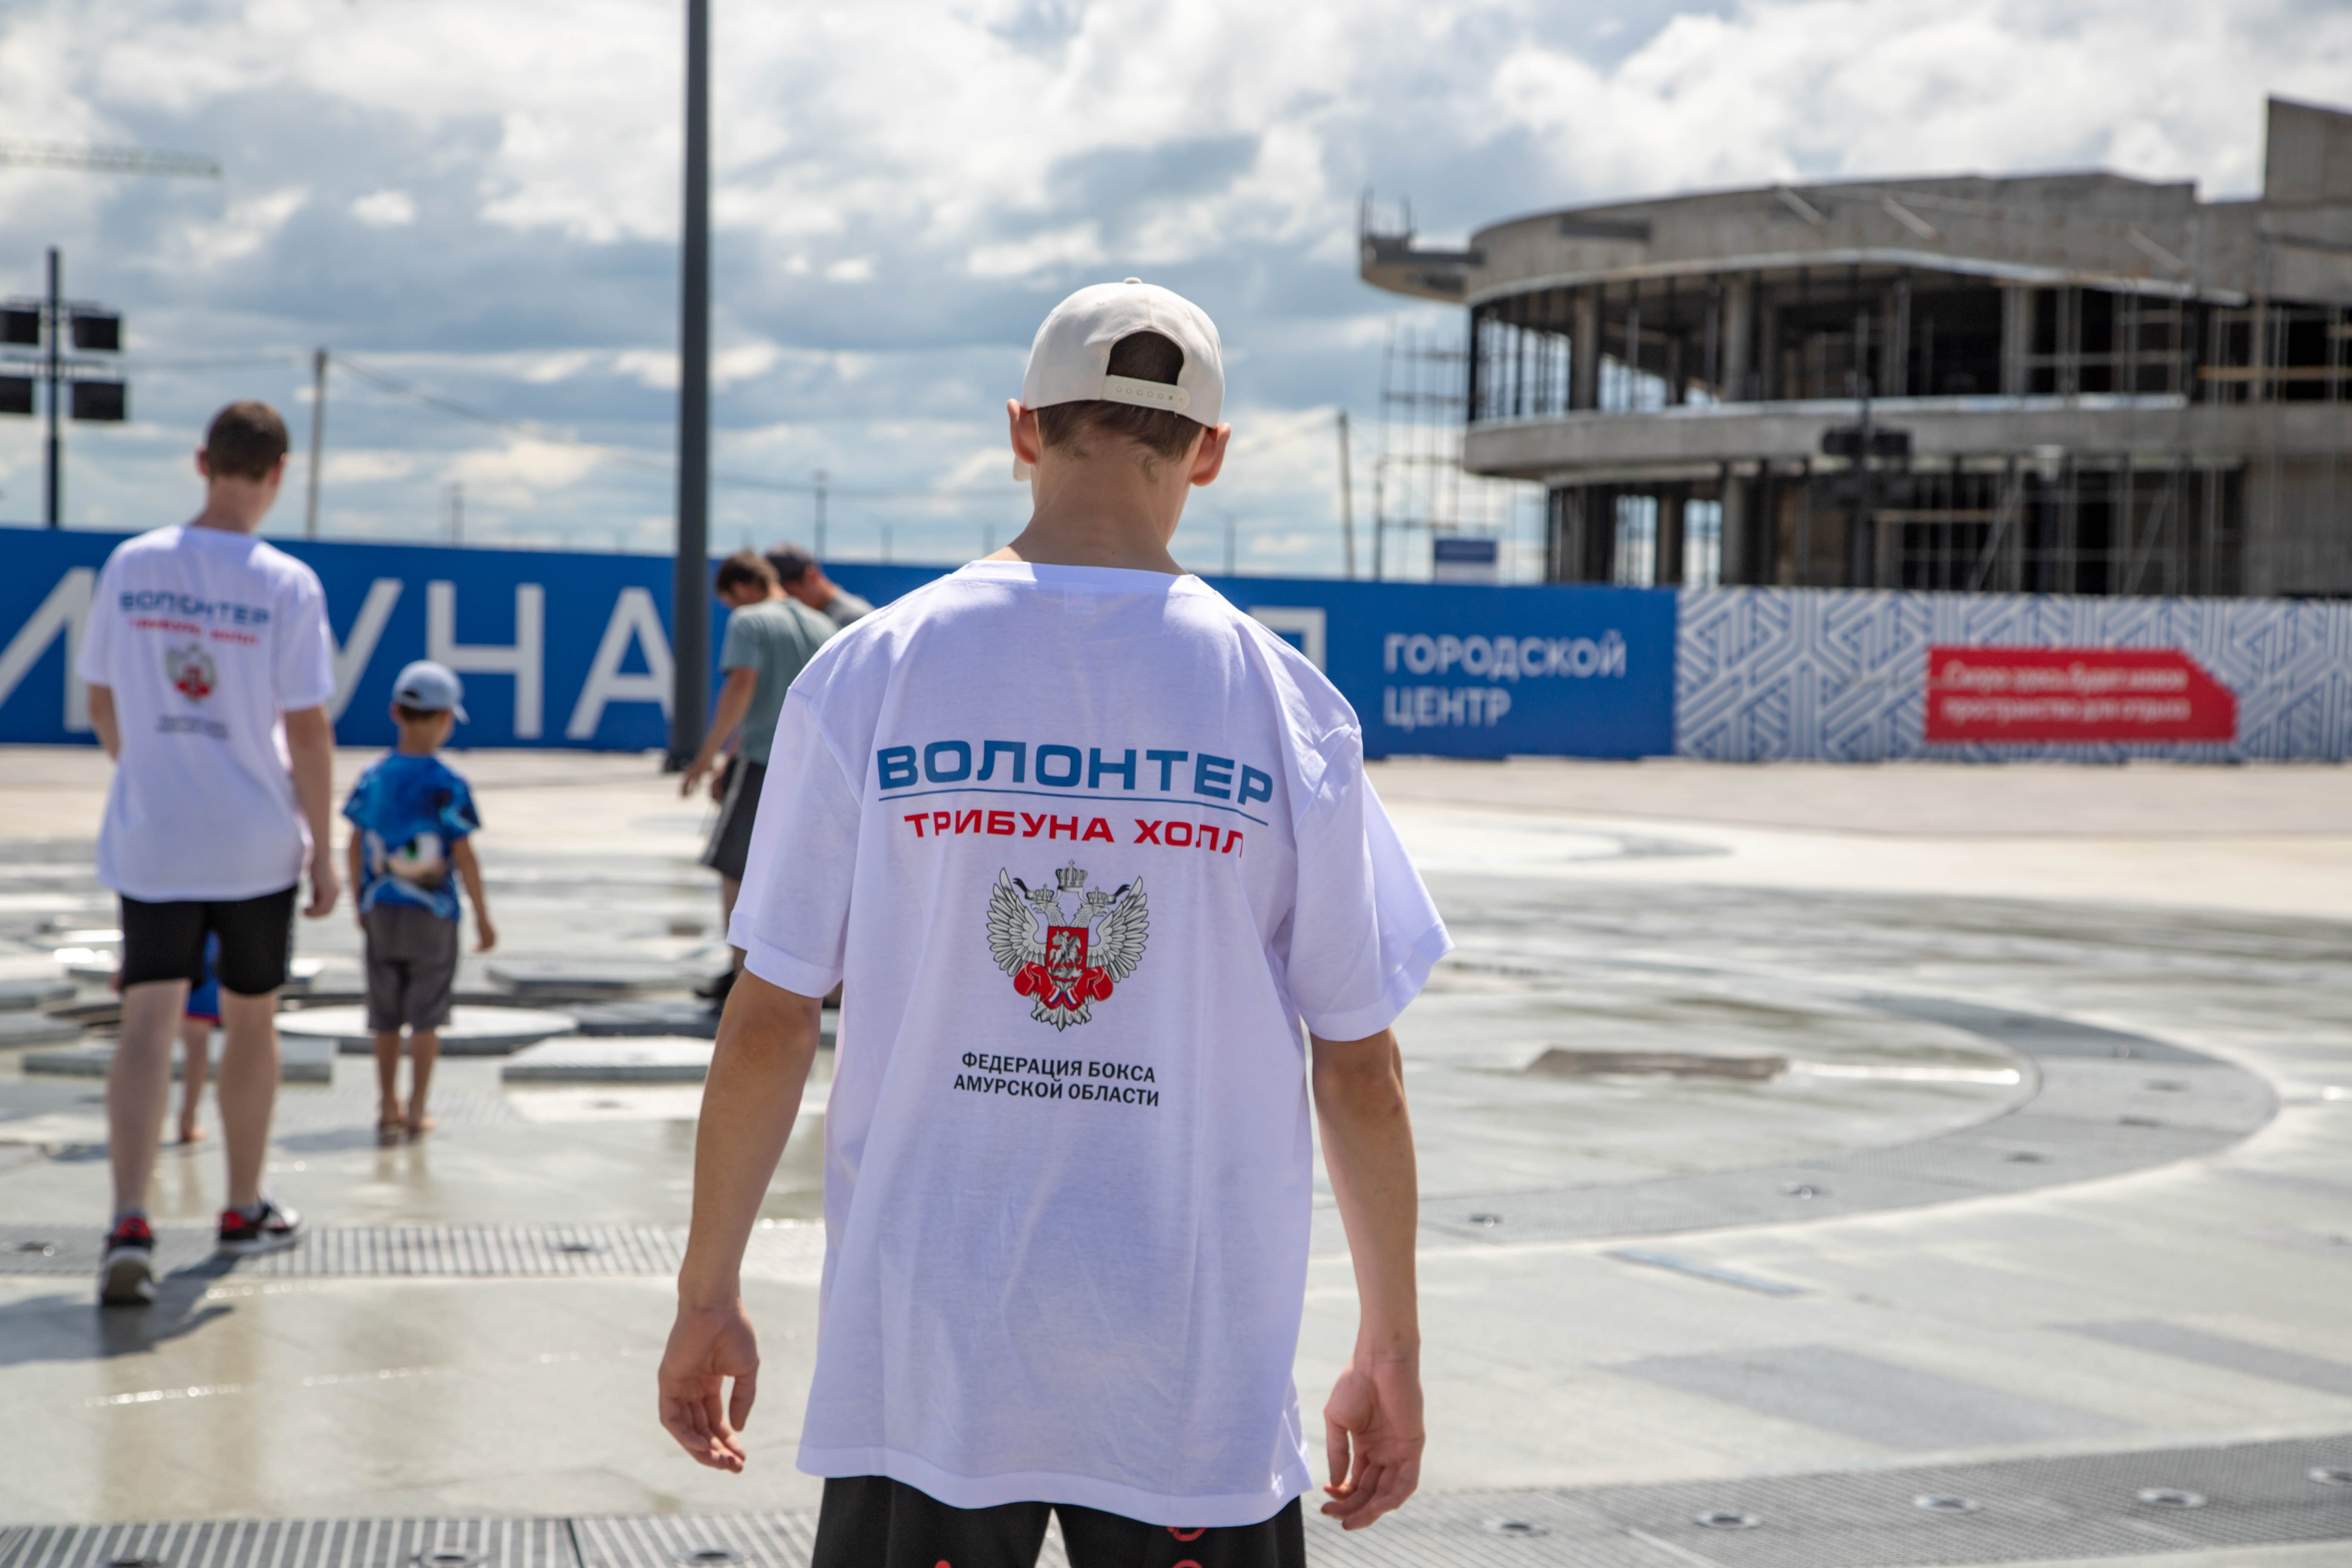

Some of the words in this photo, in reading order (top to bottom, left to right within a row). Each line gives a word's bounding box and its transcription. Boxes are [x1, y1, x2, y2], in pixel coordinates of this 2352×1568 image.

[119, 589, 271, 626] ВОЛОНТЕР
[1384, 629, 1627, 679] ГОРОДСКОЙ
[1383, 687, 1510, 730] ЦЕНТР
[876, 740, 1274, 806] ВОЛОНТЕР
[904, 809, 1115, 843] ТРИБУНА
[1133, 819, 1244, 858] ХОЛЛ
[962, 1052, 1083, 1078] ФЕДЕРАЦИЯ
[1088, 1061, 1156, 1083] БОКСА
[954, 1074, 1063, 1099] АМУРСКОЙ
[1068, 1083, 1160, 1107] ОБЛАСТИ
